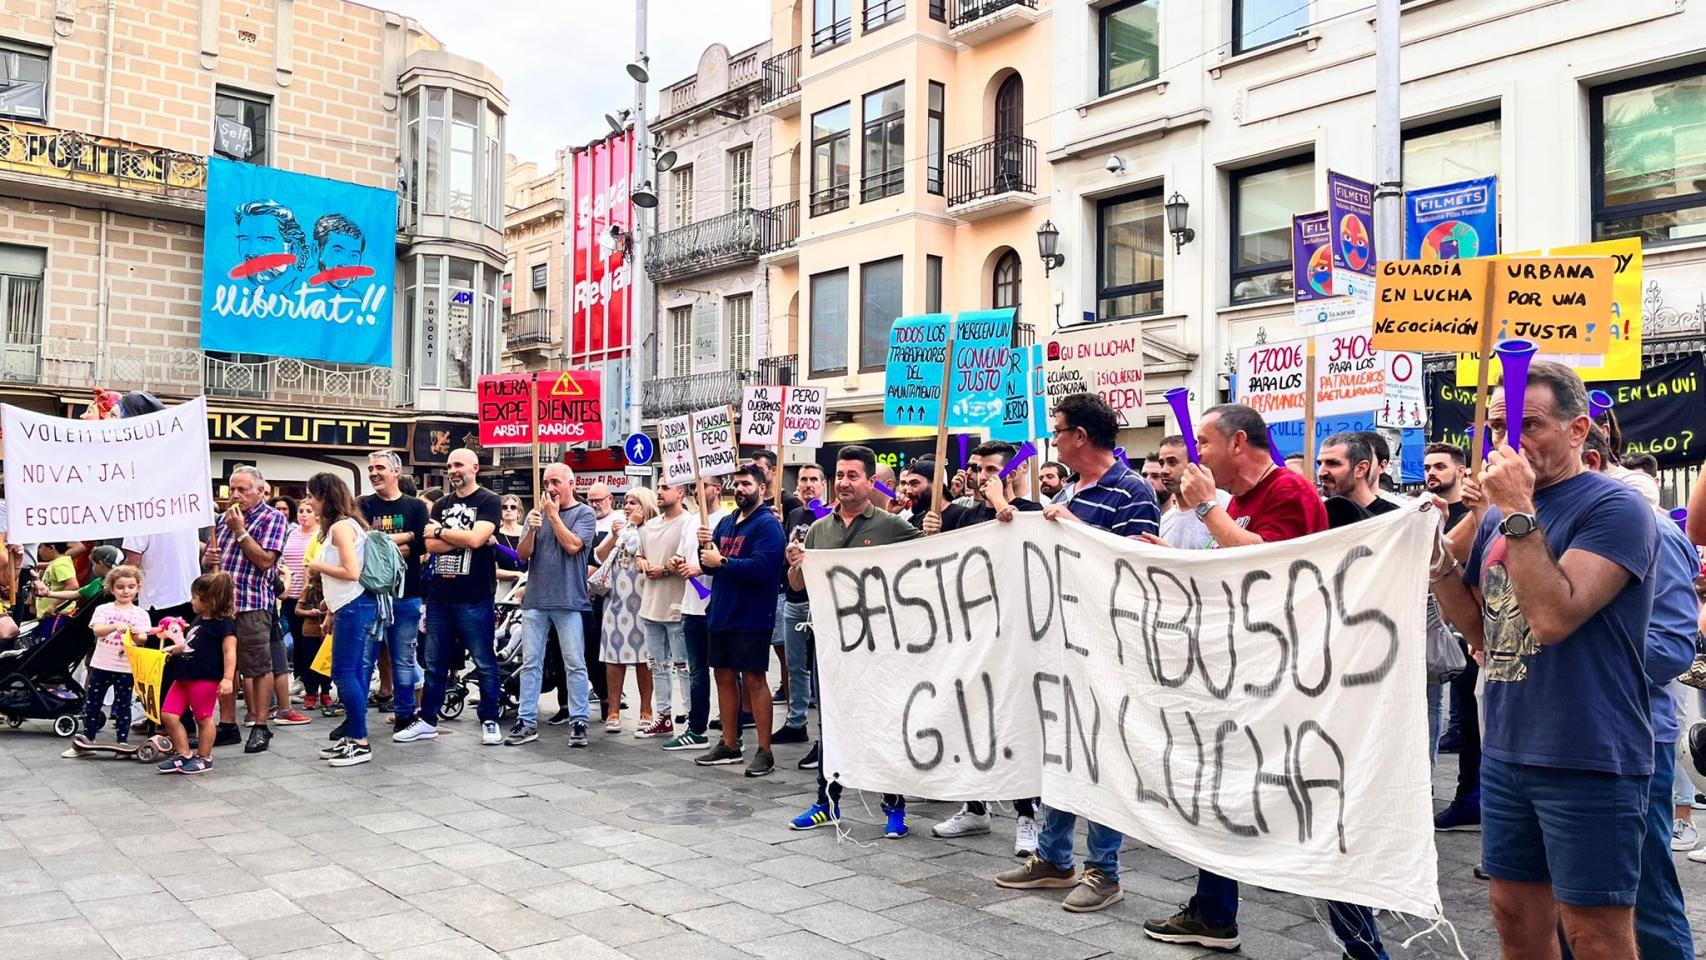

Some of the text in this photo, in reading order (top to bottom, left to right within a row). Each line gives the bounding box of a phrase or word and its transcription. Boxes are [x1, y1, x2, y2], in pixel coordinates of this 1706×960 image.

[1336, 187, 1369, 205] FILMETS
[1421, 192, 1482, 210] FILMETS
[1306, 222, 1328, 233] FIL
[1508, 264, 1594, 280] URBANA
[1381, 288, 1472, 303] EN LUCHA
[1508, 290, 1587, 307] POR UNA
[427, 300, 435, 357] ADVOCAT
[894, 324, 946, 344] TODOS LOS
[957, 321, 1010, 340] MERECEN UN
[890, 346, 946, 363] TRABAJADORES
[957, 344, 1010, 369] CONVENIO
[1061, 338, 1135, 361] GU EN LUCHA!
[1329, 335, 1377, 362] 340€
[906, 364, 924, 381] DEL
[1328, 357, 1376, 374] PARA LOS
[484, 379, 529, 396] FUERA
[957, 369, 1001, 392] JUSTO
[1249, 373, 1302, 392] PARA LOS
[792, 389, 820, 402] PERO
[887, 382, 941, 400] AYUNTAMIENTO
[1189, 391, 1195, 401] 2
[1617, 385, 1642, 403] EN
[1646, 382, 1668, 398] LA
[483, 395, 601, 422] EXPE DIENTES
[753, 411, 774, 422] ESTAR
[787, 404, 821, 415] NOS HAN
[696, 412, 731, 430] MENSUAL
[662, 438, 690, 454] A QUIEN
[702, 430, 728, 445] PERO
[23, 464, 83, 484] NOVA
[669, 462, 692, 478] GANA
[575, 475, 596, 486] Bazar
[827, 541, 1402, 700] BASTA DE ABUSOS
[901, 671, 1347, 854] G.U. EN LUCHA
